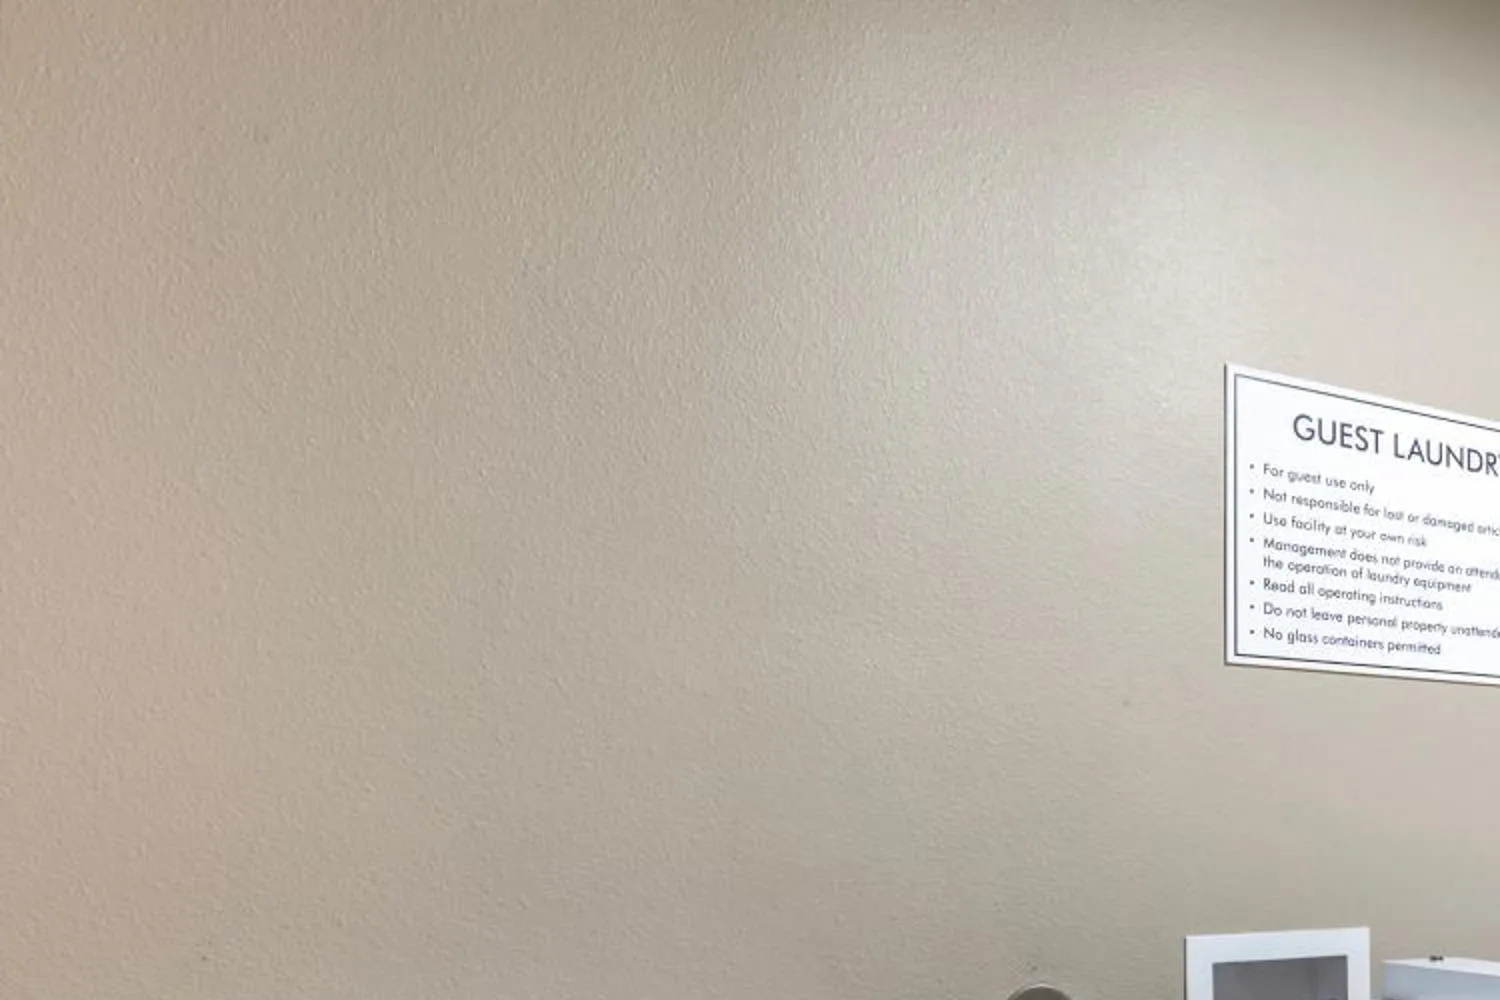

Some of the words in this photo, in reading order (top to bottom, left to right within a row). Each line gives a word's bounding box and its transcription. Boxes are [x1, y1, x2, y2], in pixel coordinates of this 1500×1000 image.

[1292, 412, 1385, 455] GUEST
[1263, 462, 1284, 478] For
[1287, 470, 1321, 484] guest
[1325, 476, 1346, 489] use
[1349, 479, 1375, 495] only
[1263, 487, 1286, 503] Not
[1291, 494, 1361, 514] responsible
[1363, 503, 1381, 517] for
[1383, 506, 1404, 521] lost
[1407, 512, 1420, 523] or
[1421, 513, 1475, 533] damaged
[1263, 511, 1287, 527] Use
[1291, 515, 1331, 536] facility
[1334, 525, 1347, 536] at
[1349, 528, 1376, 540] your
[1379, 531, 1405, 544] own
[1407, 533, 1428, 548] risk
[1263, 537, 1347, 559] Management
[1349, 548, 1379, 563] does
[1381, 554, 1401, 566] not
[1403, 558, 1445, 574] provide
[1447, 564, 1464, 575] an
[1263, 555, 1284, 570] the
[1287, 560, 1347, 577] operation
[1351, 566, 1364, 579] of
[1366, 567, 1410, 588] laundry
[1413, 576, 1471, 593] equipment
[1263, 577, 1295, 594] Read
[1299, 581, 1315, 596] all
[1317, 587, 1376, 606] operating
[1379, 590, 1443, 611] instructions
[1263, 601, 1283, 617] Do
[1285, 606, 1307, 620] not
[1311, 606, 1343, 623] leave
[1347, 614, 1398, 628] personal
[1401, 620, 1448, 637] property
[1263, 626, 1283, 641] No
[1287, 628, 1319, 645] glass
[1322, 634, 1384, 651] containers
[1387, 640, 1442, 656] permitted
